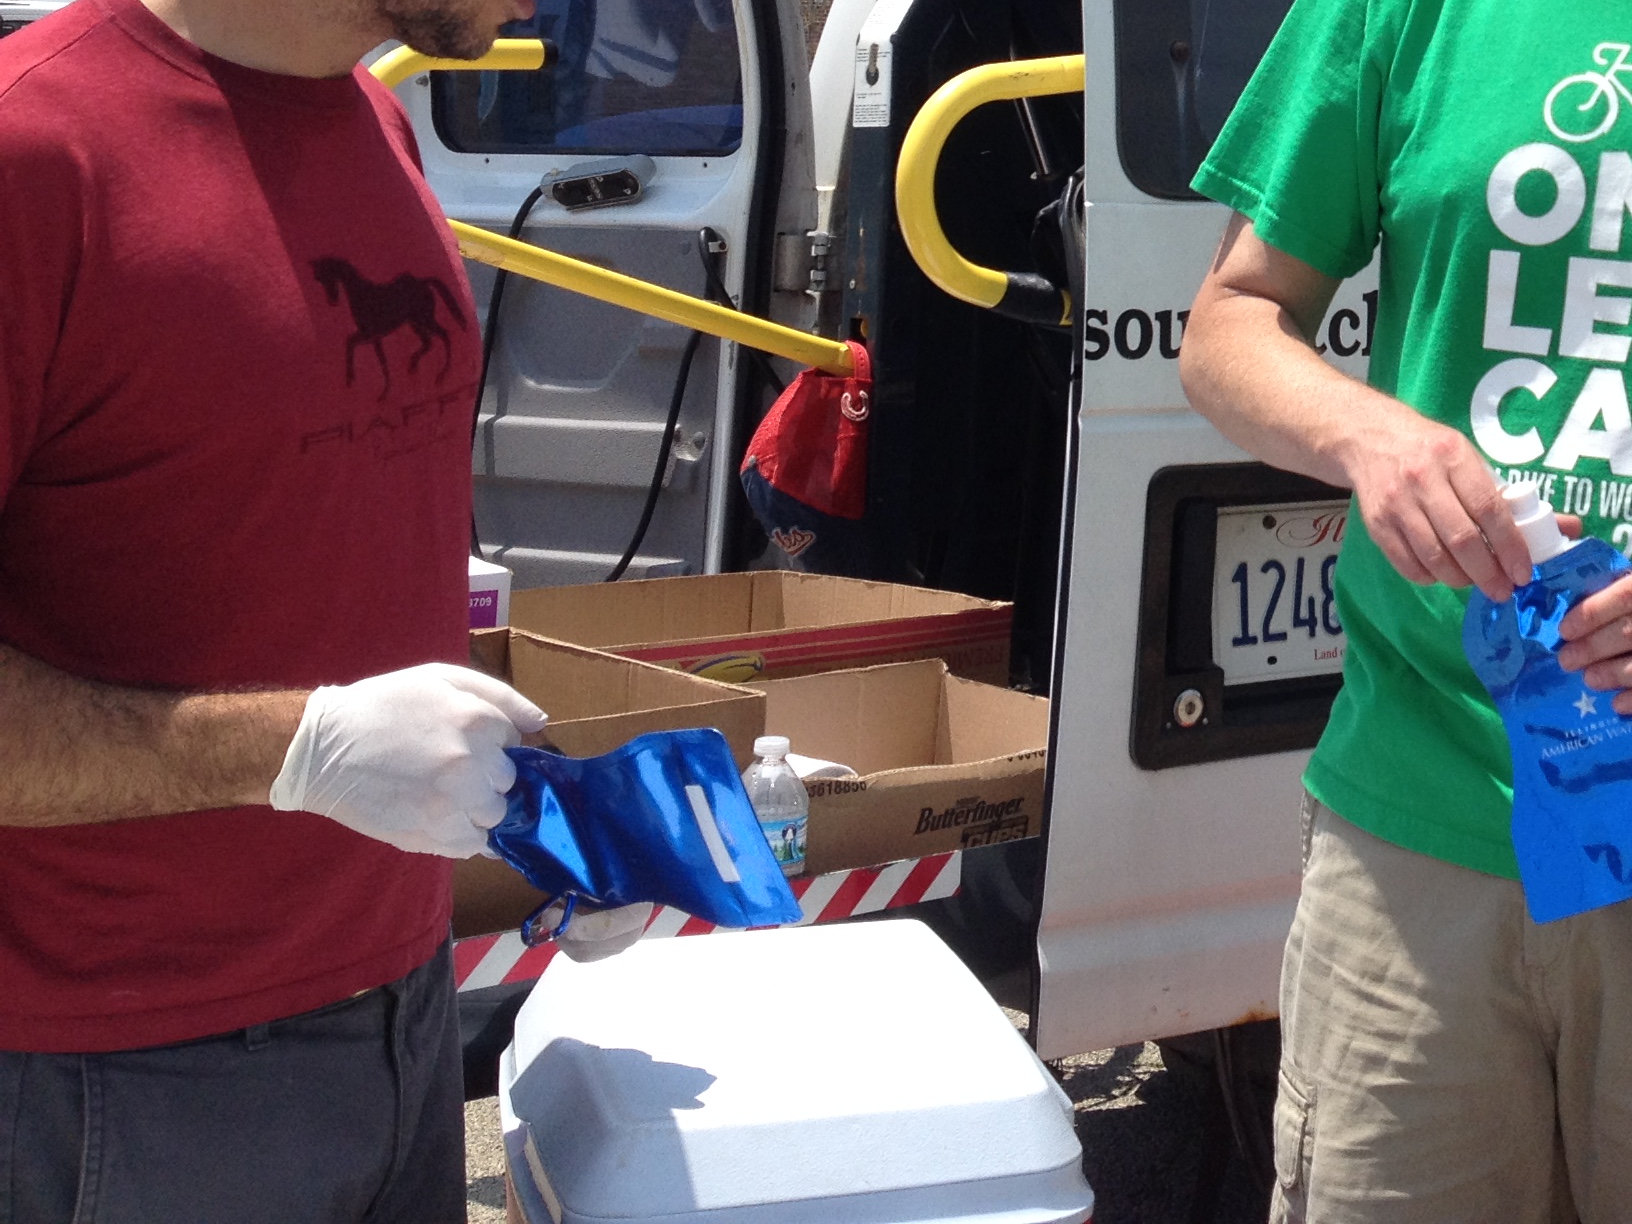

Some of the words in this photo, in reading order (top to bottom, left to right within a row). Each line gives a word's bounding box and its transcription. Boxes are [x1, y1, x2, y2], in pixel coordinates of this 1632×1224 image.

[1563, 476, 1593, 516] TO
[1314, 648, 1338, 661] Land
[1541, 733, 1604, 760] AMERICAN
[913, 796, 1026, 836] Butterfinger
